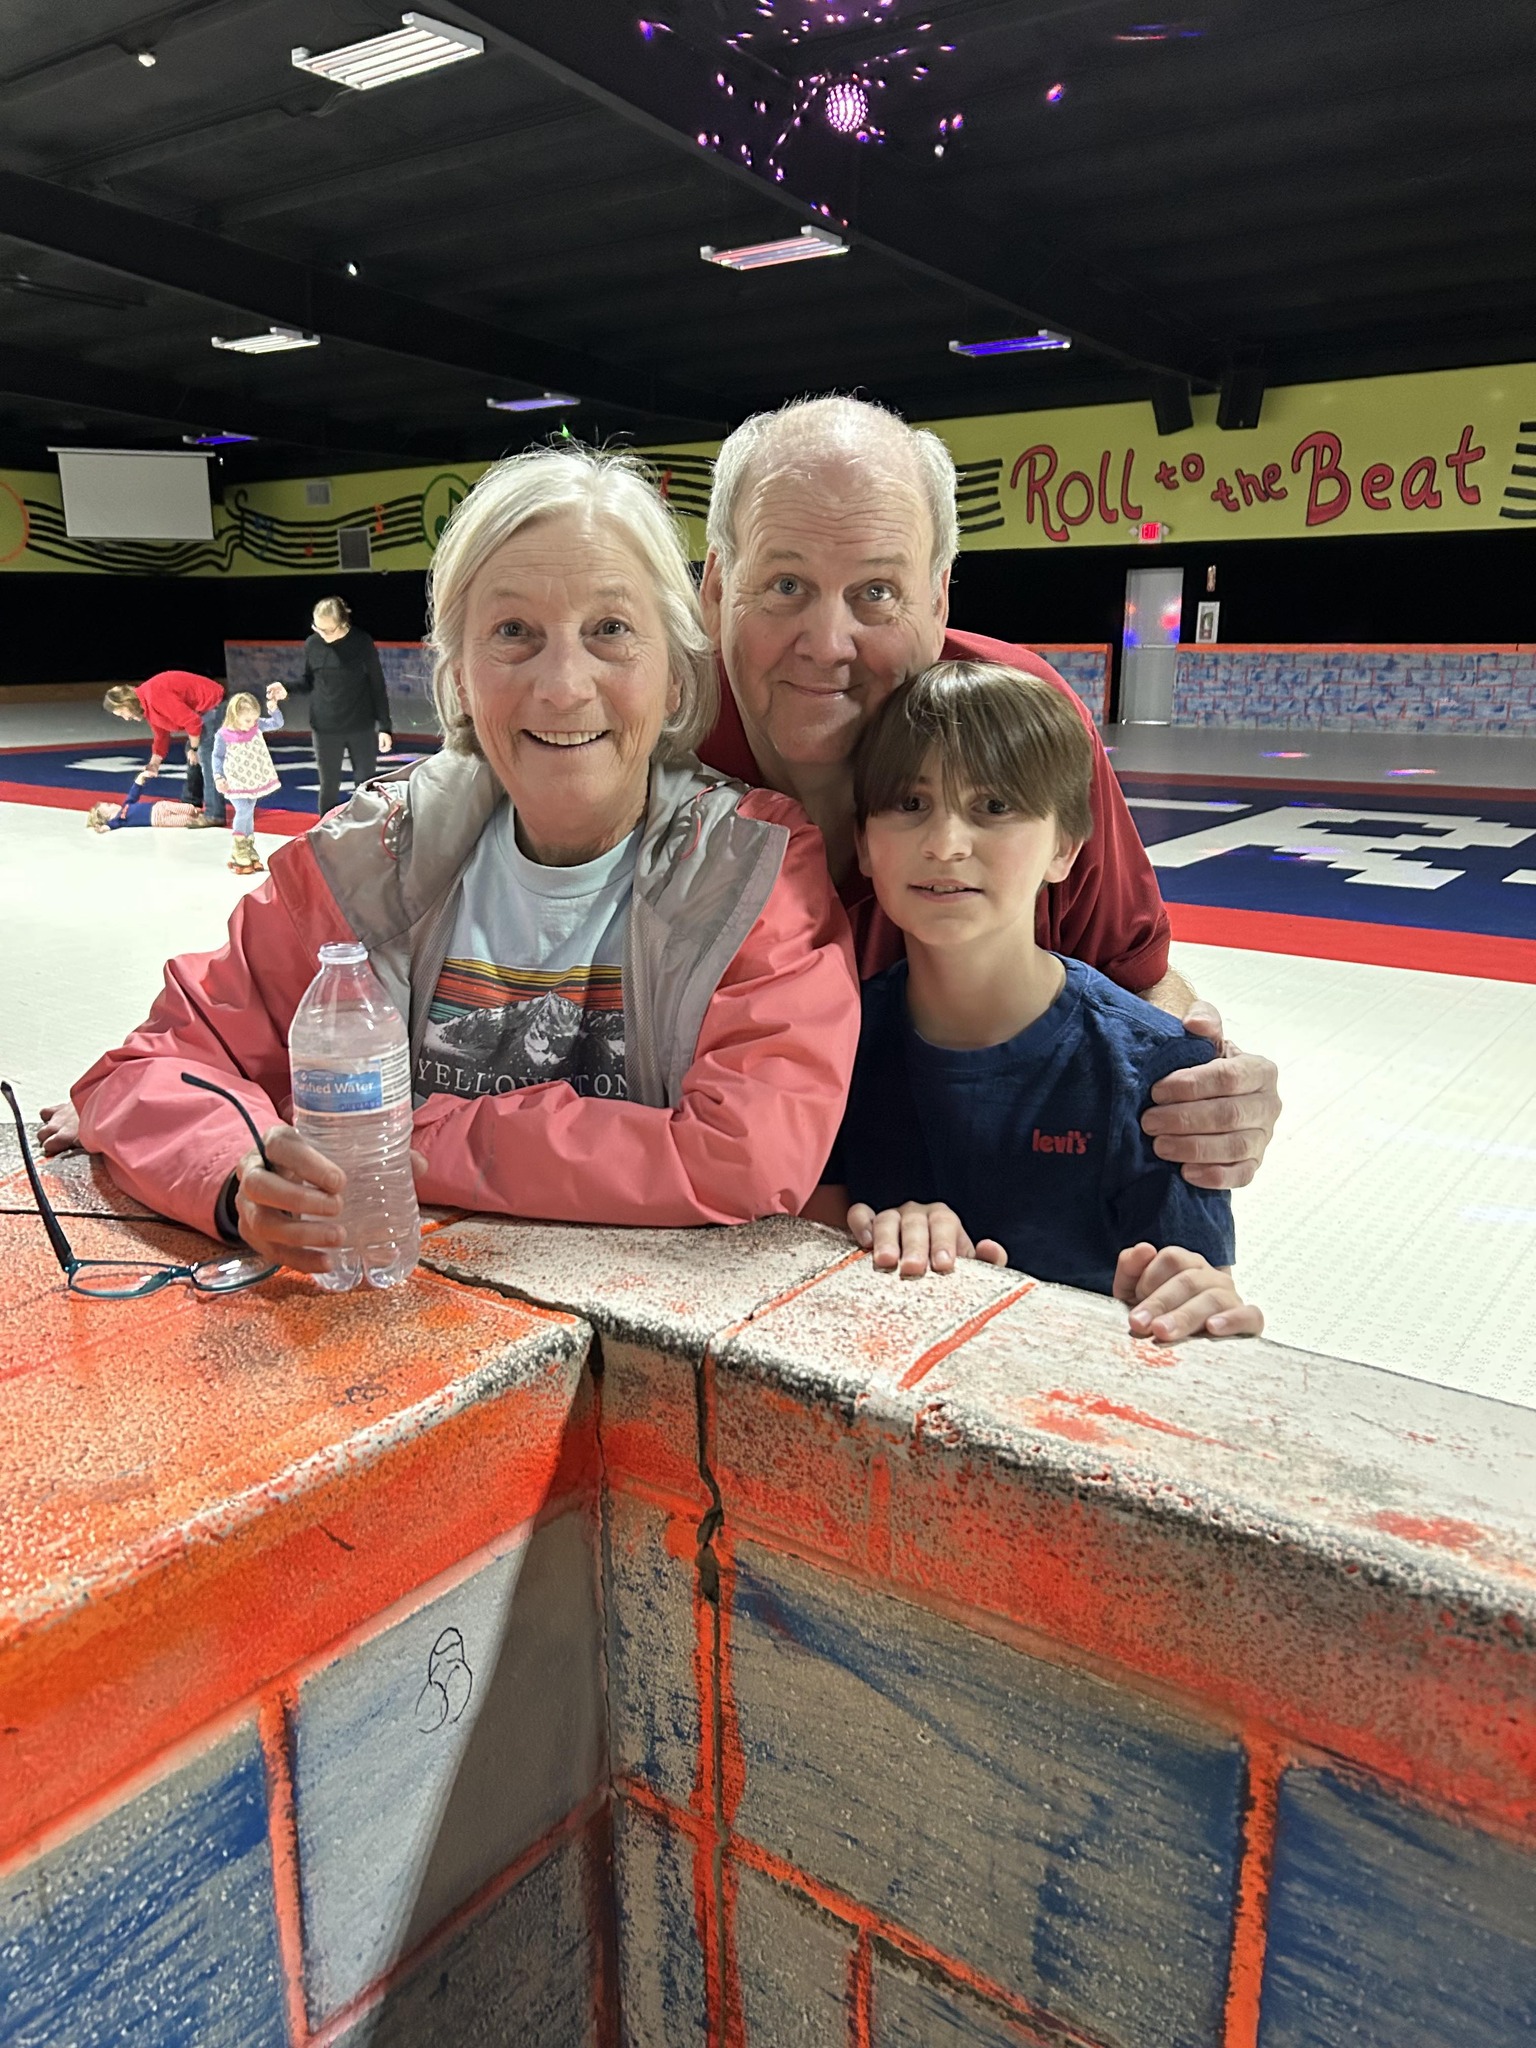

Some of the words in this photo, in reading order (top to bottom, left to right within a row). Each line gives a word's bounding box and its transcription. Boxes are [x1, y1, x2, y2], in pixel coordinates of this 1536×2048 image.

[1010, 444, 1143, 542] Roll
[1155, 452, 1205, 490] to
[1211, 463, 1288, 512] the
[1291, 425, 1487, 527] Beat
[1142, 523, 1160, 539] EXIT
[334, 1081, 374, 1094] Water
